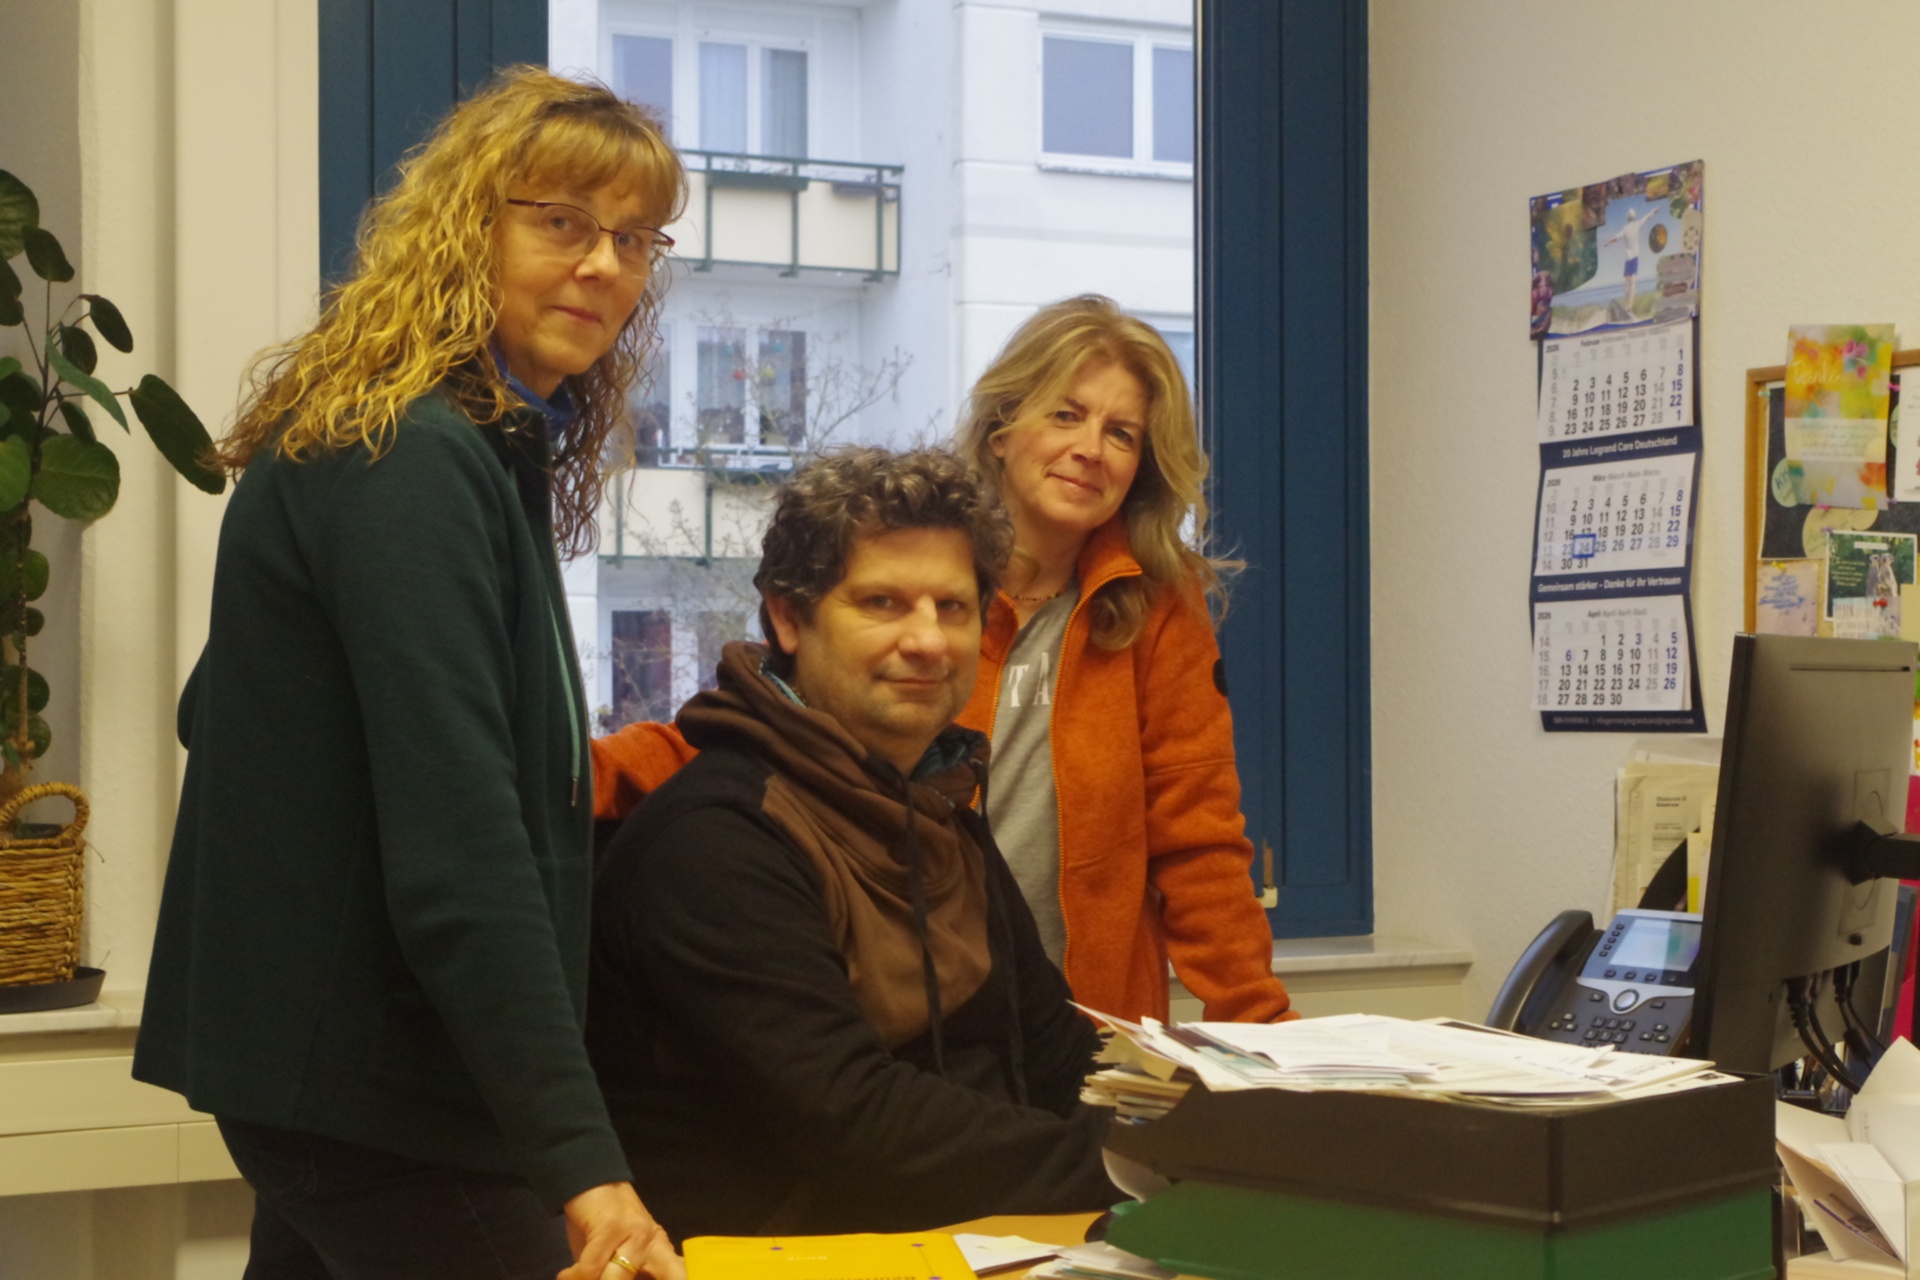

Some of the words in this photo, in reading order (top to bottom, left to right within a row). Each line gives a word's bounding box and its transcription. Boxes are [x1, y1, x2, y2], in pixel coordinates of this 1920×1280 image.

[1679, 349, 1683, 360] 1
[1573, 379, 1579, 391] 2
[1590, 377, 1595, 388] 3
[1606, 375, 1612, 385] 4
[1624, 372, 1629, 383] 5
[1640, 369, 1647, 381] 6
[1660, 366, 1665, 378] 7
[1678, 364, 1683, 376] 8
[1573, 394, 1578, 405] 9
[1585, 392, 1595, 403] 10
[1601, 390, 1610, 400] 11
[1618, 386, 1628, 398] 12
[1635, 384, 1646, 396] 13
[1654, 382, 1664, 394] 14
[1672, 379, 1682, 391] 15
[1567, 408, 1577, 420] 16
[1585, 406, 1594, 417] 17
[1601, 404, 1611, 415] 18
[1618, 401, 1627, 413] 19
[1634, 399, 1645, 411] 20
[1652, 397, 1663, 409] 21
[1670, 394, 1682, 407] 22
[1565, 423, 1576, 435] 23
[1582, 421, 1593, 433] 24
[1599, 418, 1610, 431] 25
[1616, 416, 1627, 428] 26
[1633, 414, 1645, 426] 27
[1651, 411, 1663, 424] 28
[1677, 410, 1681, 420] 1
[1572, 448, 1588, 457] Jahre
[1590, 443, 1616, 456] Legrand
[1618, 442, 1633, 451] Care
[1635, 436, 1677, 449] Deutschland
[1572, 500, 1578, 512] 2
[1588, 498, 1594, 510] 3
[1605, 497, 1610, 507] 4
[1623, 495, 1628, 506] 5
[1640, 493, 1646, 505] 6
[1659, 491, 1664, 503] 7
[1677, 490, 1683, 502] 8
[1571, 515, 1576, 526] 9
[1583, 513, 1593, 524] 10
[1600, 512, 1609, 522] 11
[1617, 510, 1627, 521] 12
[1634, 508, 1645, 520] 13
[1652, 507, 1662, 518] 14
[1671, 505, 1681, 516] 15
[1565, 529, 1575, 540] 16
[1598, 526, 1608, 538] 18
[1615, 524, 1625, 536] 19
[1631, 523, 1643, 535] 20
[1649, 522, 1661, 534] 21
[1667, 520, 1680, 532] 22
[1562, 542, 1574, 554] 23
[1578, 543, 1590, 554] 24
[1595, 540, 1606, 552] 25
[1612, 539, 1624, 551] 26
[1630, 538, 1642, 550] 27
[1648, 536, 1660, 549] 28
[1666, 535, 1679, 547] 29
[1561, 558, 1572, 569] 30
[1578, 557, 1588, 568] 31
[1538, 582, 1574, 592] Gemeinsam
[1576, 580, 1598, 590] stärker
[1604, 579, 1624, 589] Danke
[1626, 578, 1635, 588] für
[1637, 578, 1645, 586] Ihr
[1648, 576, 1681, 586] Vertrauen
[1602, 635, 1605, 645] 1
[1618, 634, 1624, 645] 2
[1636, 633, 1641, 645] 3
[1653, 633, 1659, 644] 4
[1672, 632, 1677, 644] 5
[1566, 650, 1572, 661] 6
[1584, 650, 1588, 660] 7
[1600, 649, 1606, 661] 8
[1618, 648, 1623, 660] 9
[1630, 648, 1641, 660] 10
[1648, 648, 1658, 659] 11
[1666, 647, 1677, 659] 12
[1561, 664, 1571, 676] 13
[1578, 665, 1588, 675] 14
[1595, 664, 1605, 676] 15
[1613, 664, 1623, 675] 16
[1630, 663, 1640, 674] 17
[1648, 662, 1659, 675] 18
[1666, 662, 1677, 674] 19
[1559, 679, 1570, 690] 20
[1576, 679, 1587, 690] 21
[1594, 678, 1605, 690] 22
[1611, 678, 1622, 690] 23
[1628, 678, 1640, 690] 24
[1646, 678, 1657, 690] 25
[1664, 678, 1676, 689] 26
[1558, 694, 1569, 705] 27
[1575, 694, 1587, 705] 28
[1593, 693, 1605, 705] 29
[1610, 693, 1622, 705] 30
